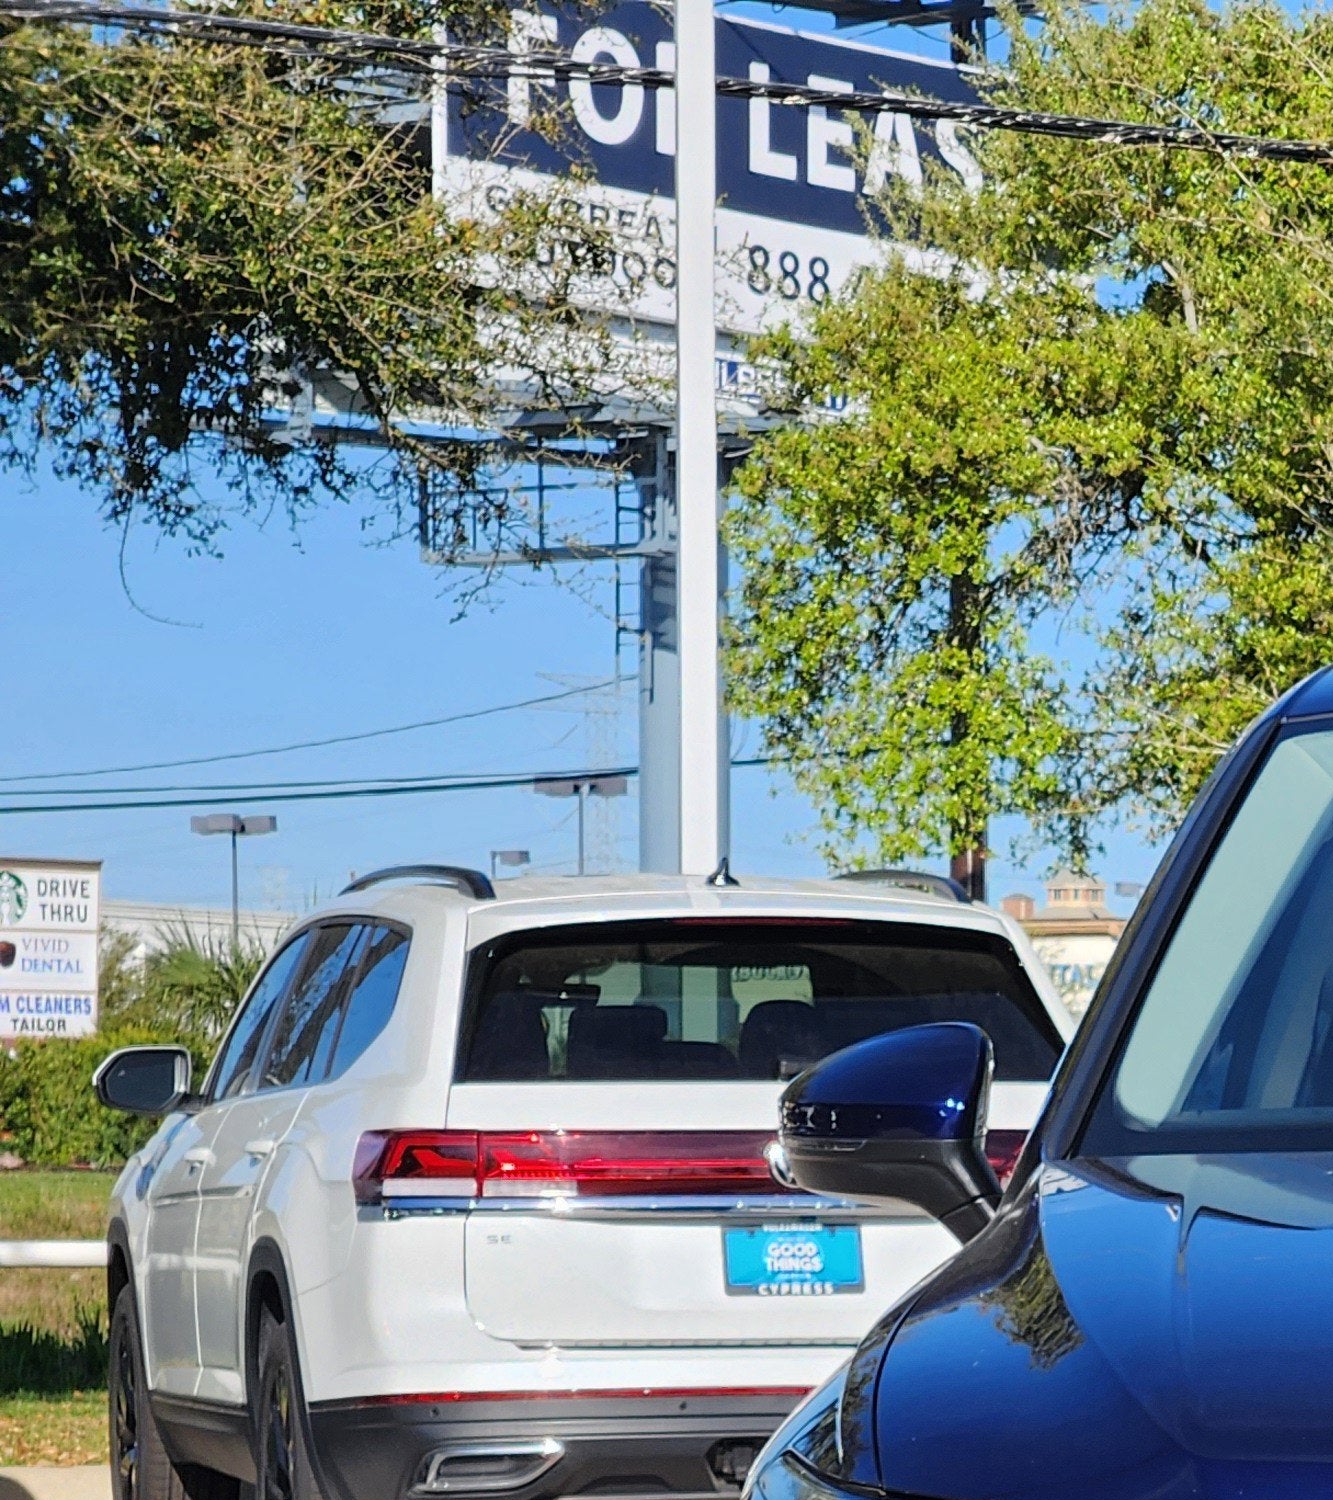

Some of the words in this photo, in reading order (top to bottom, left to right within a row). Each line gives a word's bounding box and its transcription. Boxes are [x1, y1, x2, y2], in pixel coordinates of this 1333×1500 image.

[748, 60, 985, 198] LEAS
[37, 879, 90, 899] DRIVE
[39, 904, 88, 923] THRU
[21, 937, 70, 954] VIVID
[21, 957, 84, 974] DENTAL
[16, 995, 92, 1015] CLEANERS
[10, 1017, 67, 1032] TAILOR
[767, 1241, 819, 1258] GOOD
[764, 1255, 825, 1273] THINGS
[757, 1281, 834, 1296] CYPRESS
